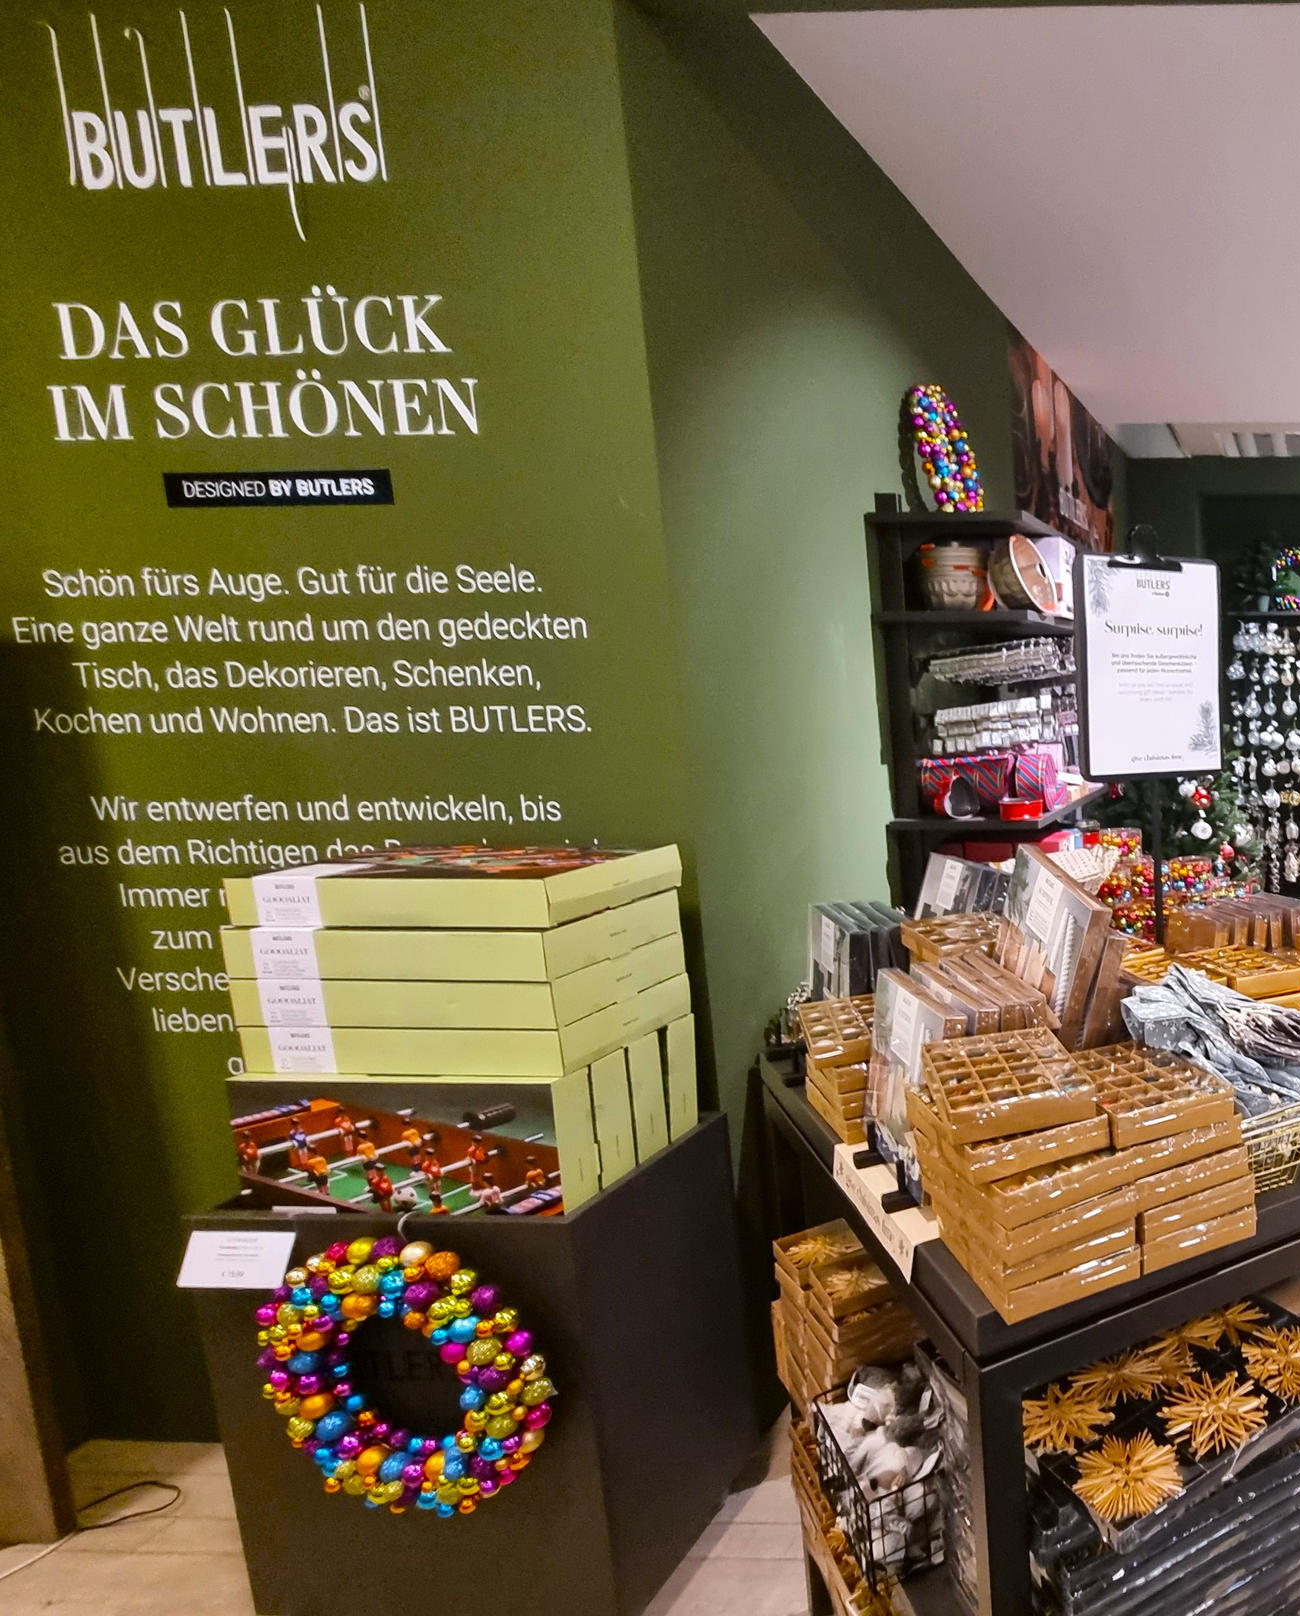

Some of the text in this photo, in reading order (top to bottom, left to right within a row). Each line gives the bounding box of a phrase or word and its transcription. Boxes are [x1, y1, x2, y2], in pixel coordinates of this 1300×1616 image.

[52, 284, 453, 360] DAS GLÜCK
[46, 369, 480, 442] IM SCHÖNEN
[182, 478, 375, 498] DESIGNED BY BUTLERS
[42, 562, 543, 602] Schön fürs Auge. Gut für die Seele.
[1136, 579, 1170, 590] BUTLERS
[12, 610, 588, 650] Eine ganze Welt rund um den gedeckten
[1157, 623, 1203, 639] surprise!
[72, 658, 541, 692] Tisch, das Dekorieren, Schenken,
[34, 705, 592, 734] Kochen und Wohnen. Das ist BUTLERS.
[90, 794, 562, 826] Wir entwerfen und entwickeln, bis
[59, 846, 109, 866] aus
[118, 841, 181, 866] dem
[187, 839, 318, 871] Richtigen
[119, 883, 211, 908] Immer
[151, 930, 213, 950] zum
[152, 1007, 234, 1033] lieben
